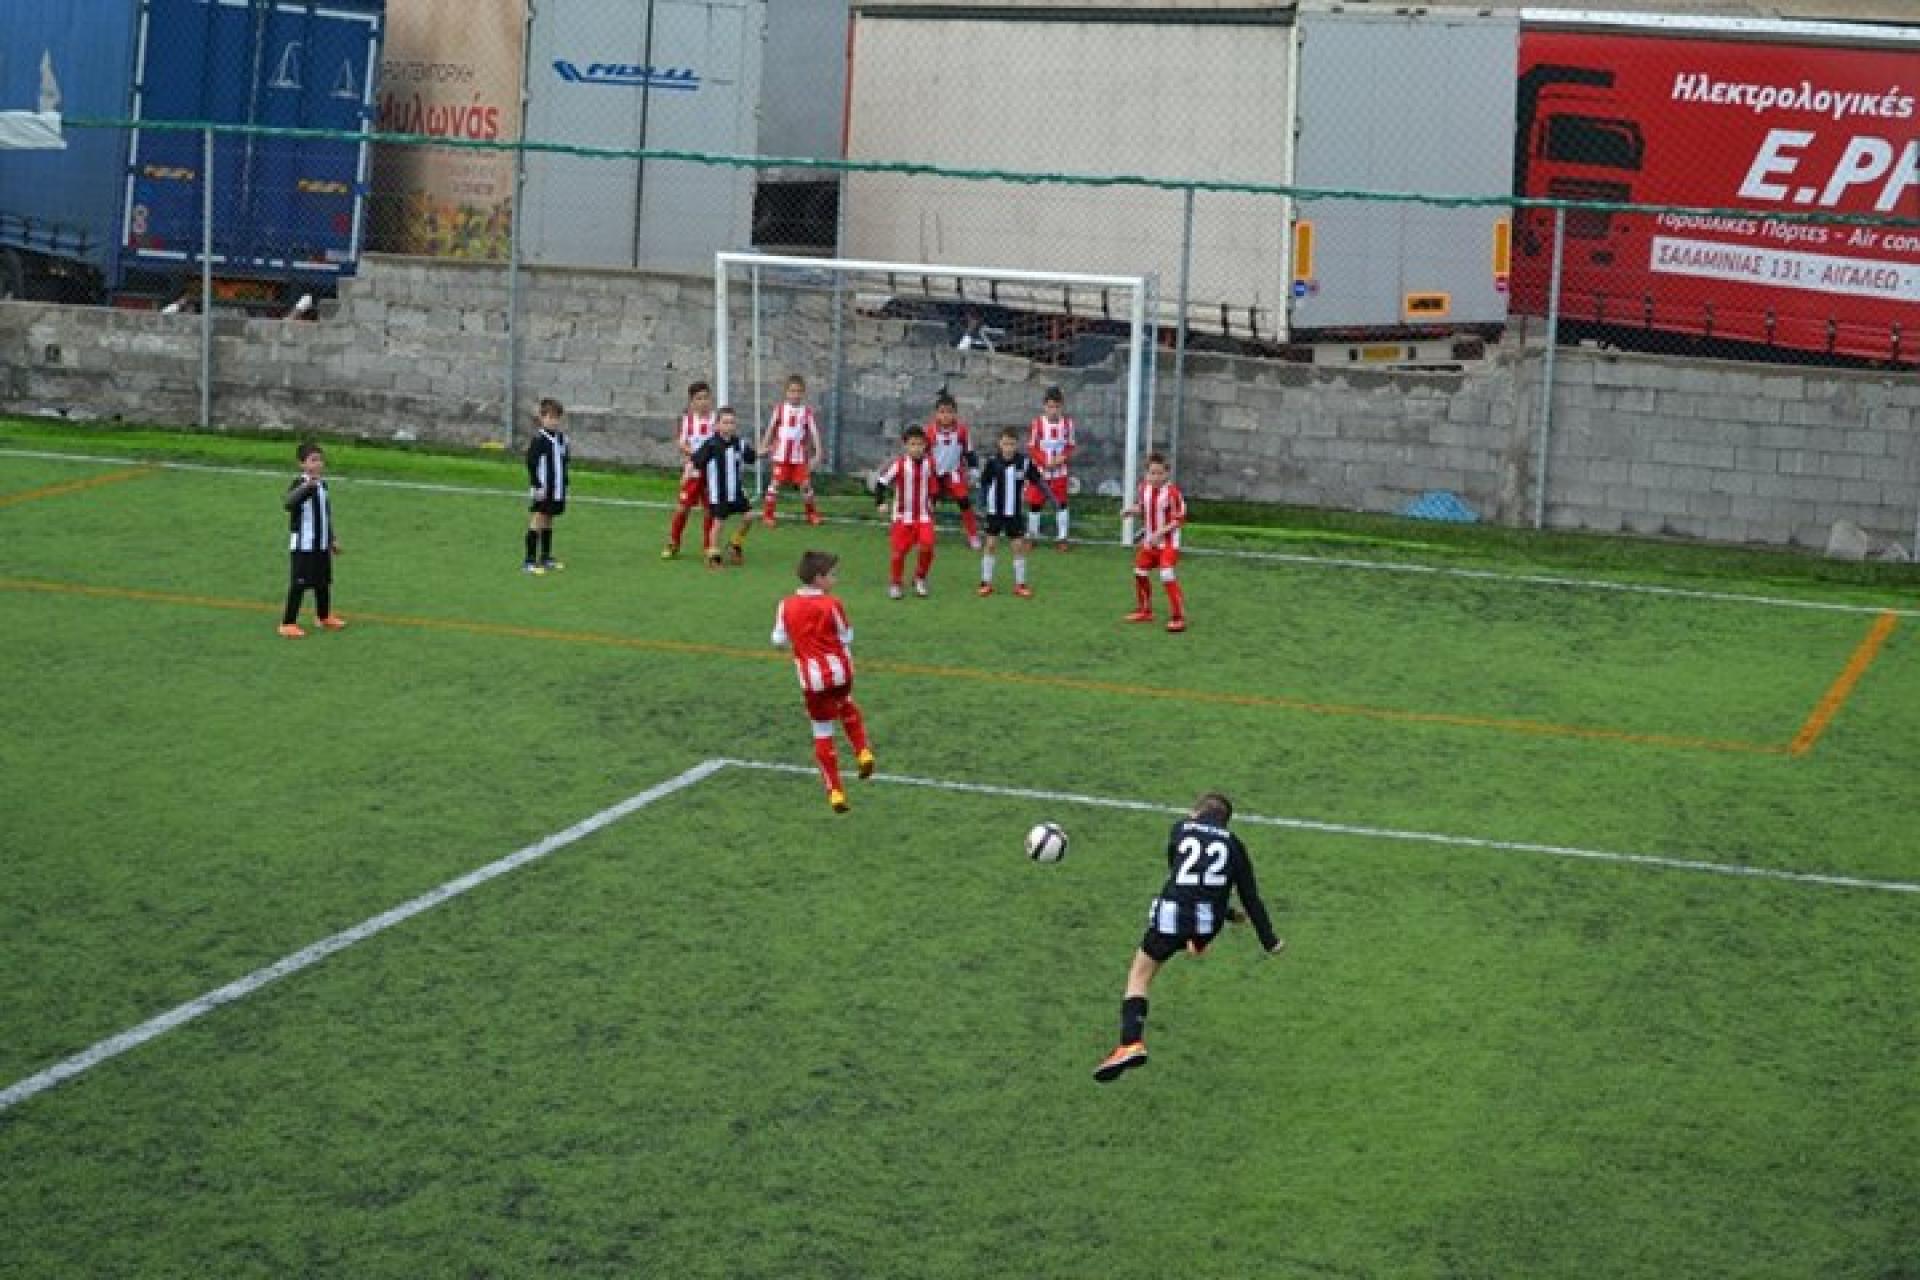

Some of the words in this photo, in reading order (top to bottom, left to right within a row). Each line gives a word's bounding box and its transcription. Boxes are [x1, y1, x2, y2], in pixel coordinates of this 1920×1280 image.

[1672, 71, 1916, 120] Ηλεκτρολογικές
[1848, 227, 1878, 248] Air
[1658, 243, 1763, 276] ΣΑΛΑΜΙΝΙΑΣ
[1769, 257, 1802, 281] 131
[1820, 262, 1900, 291] ΑΙΓΑΛΕΩ
[1175, 836, 1229, 886] 22
